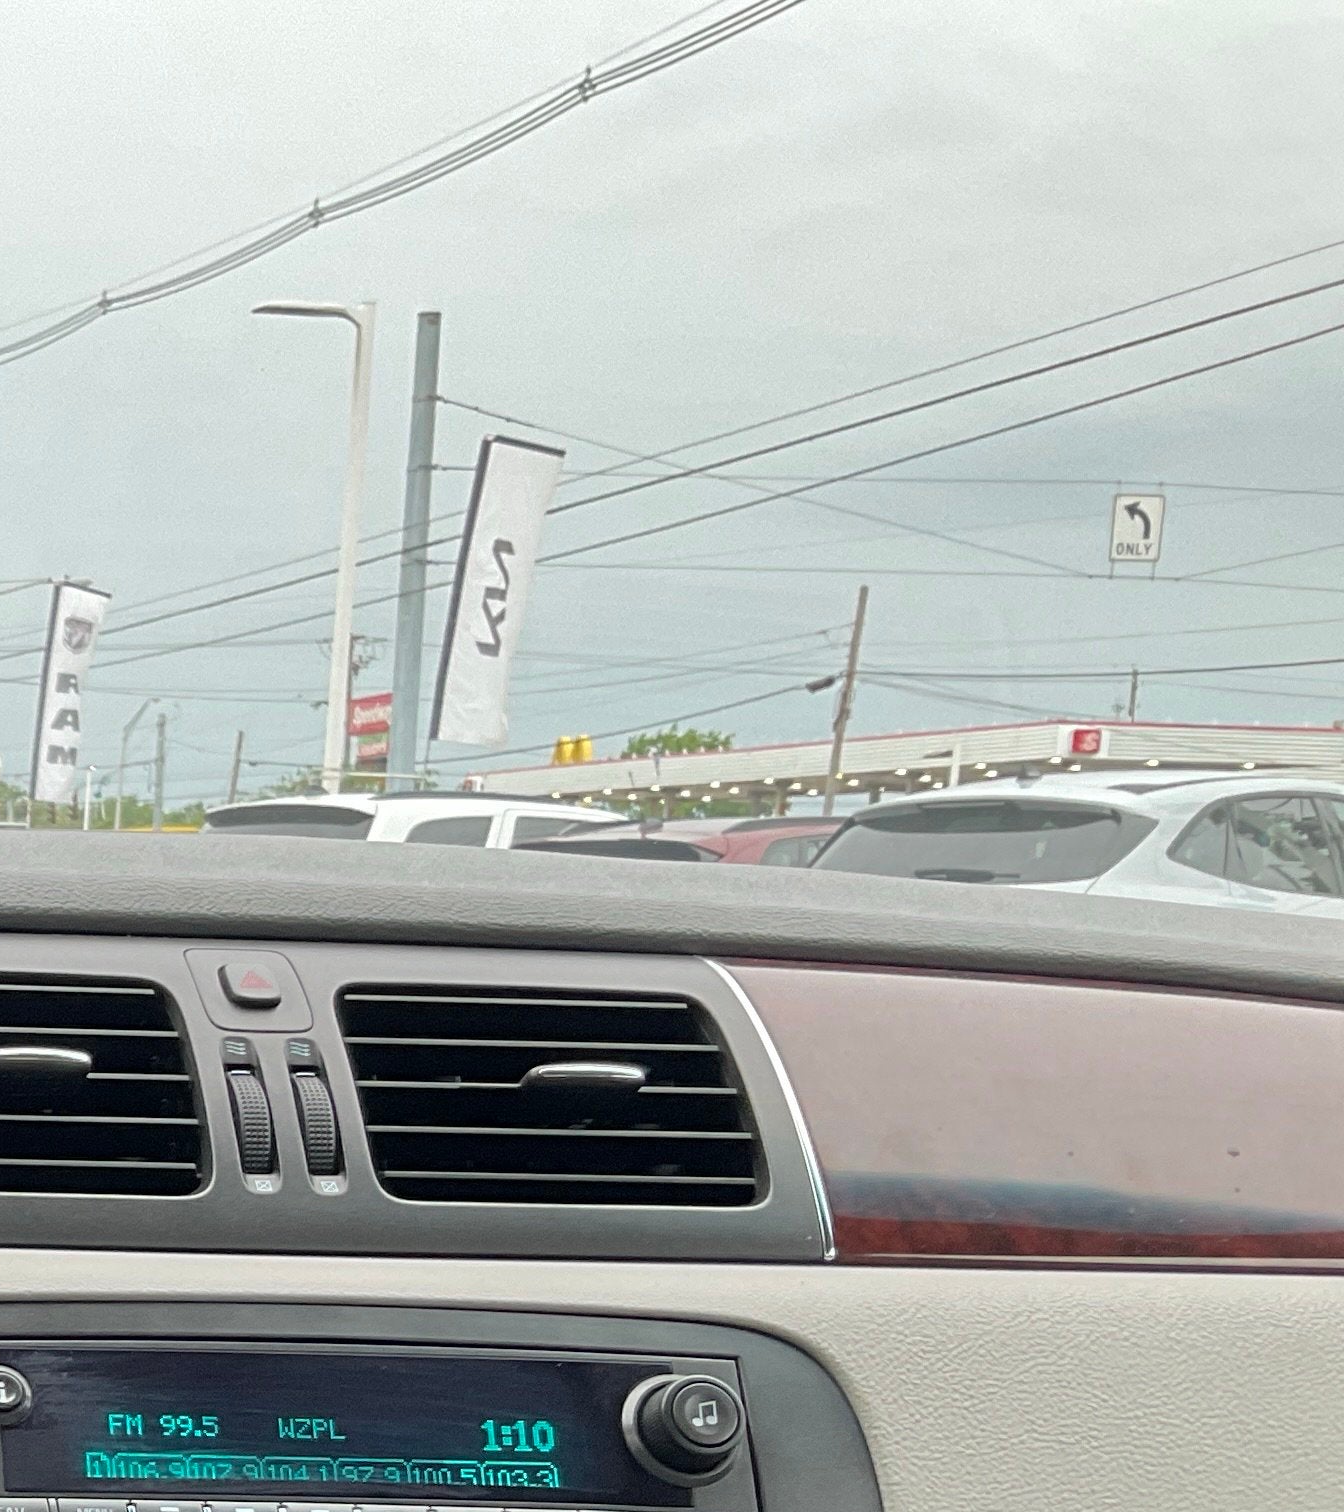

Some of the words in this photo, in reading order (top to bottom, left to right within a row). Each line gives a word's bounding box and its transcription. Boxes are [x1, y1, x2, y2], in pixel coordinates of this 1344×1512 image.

[1116, 542, 1153, 556] ONLY
[46, 672, 80, 766] RAM
[107, 1413, 144, 1436] FM
[159, 1414, 220, 1438] 99.5
[277, 1417, 346, 1440] WZPL
[480, 1419, 555, 1452] 1:10
[116, 1459, 185, 1478] 1069
[193, 1461, 259, 1479] 1079
[267, 1464, 329, 1481] 1041
[341, 1465, 401, 1483] 979
[412, 1467, 478, 1485] 1005
[486, 1468, 554, 1487] 1033
